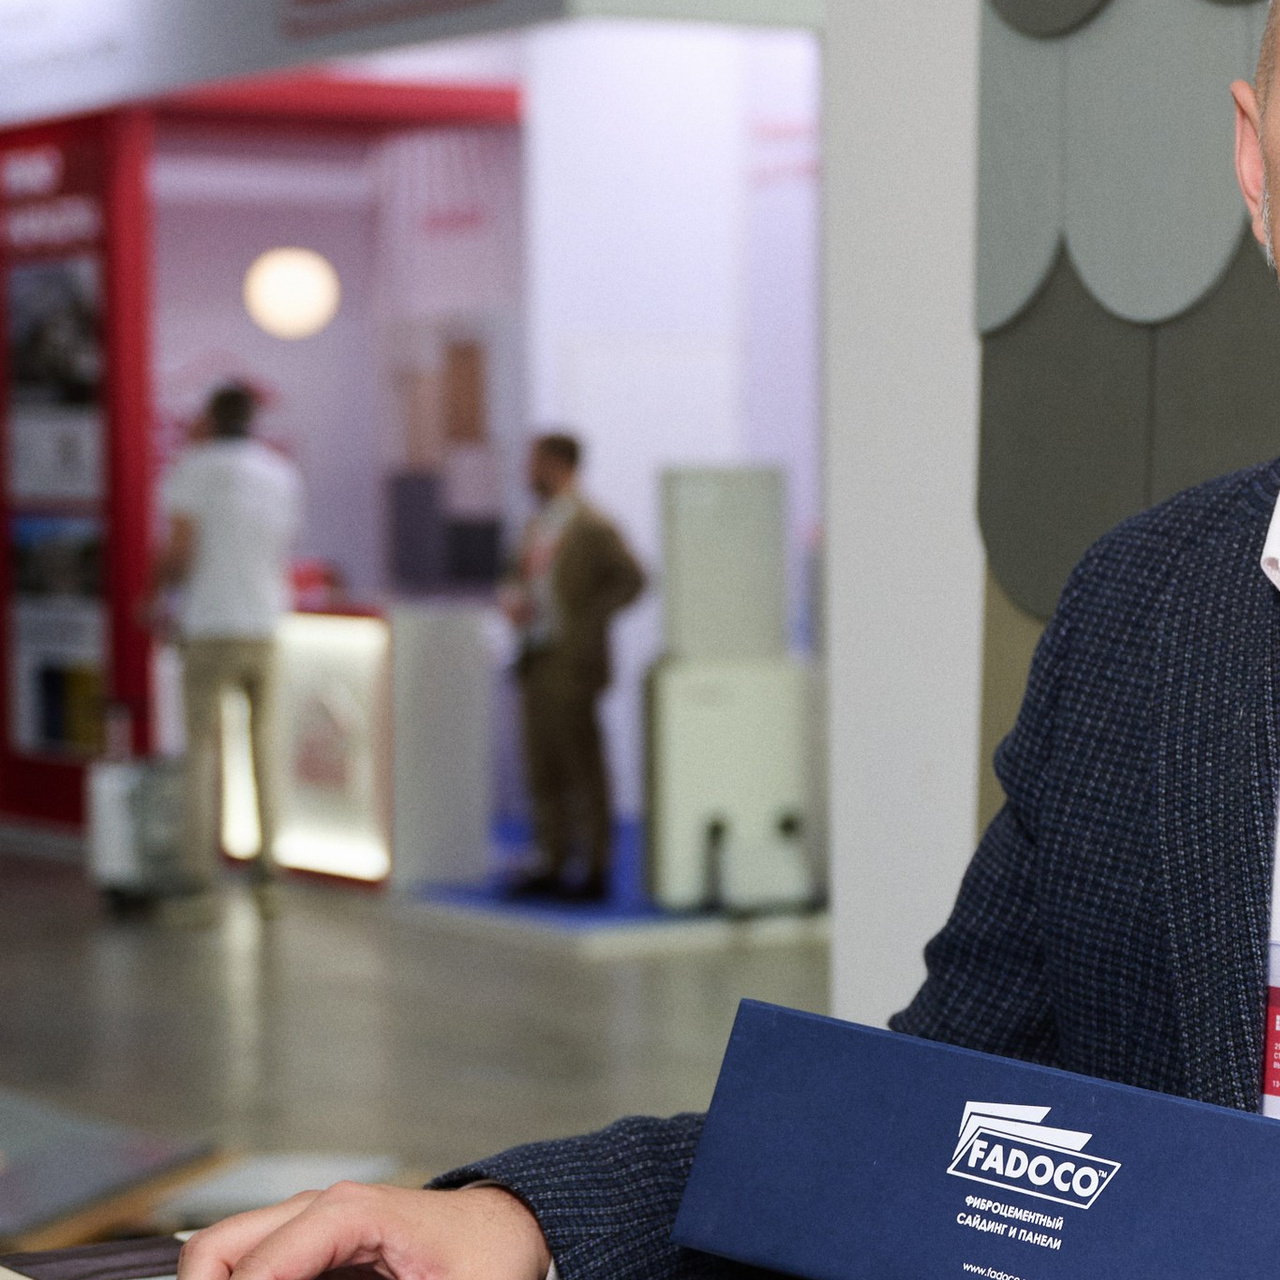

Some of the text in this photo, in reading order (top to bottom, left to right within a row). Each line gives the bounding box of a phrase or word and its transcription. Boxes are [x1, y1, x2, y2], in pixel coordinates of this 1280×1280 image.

[967, 1138, 1100, 1198] FADOCO
[956, 1212, 1062, 1251] САЙДИНГ И ПАНЕЛИ
[965, 1195, 1064, 1231] ФИБРОЦЕМЕНТНЫЙ
